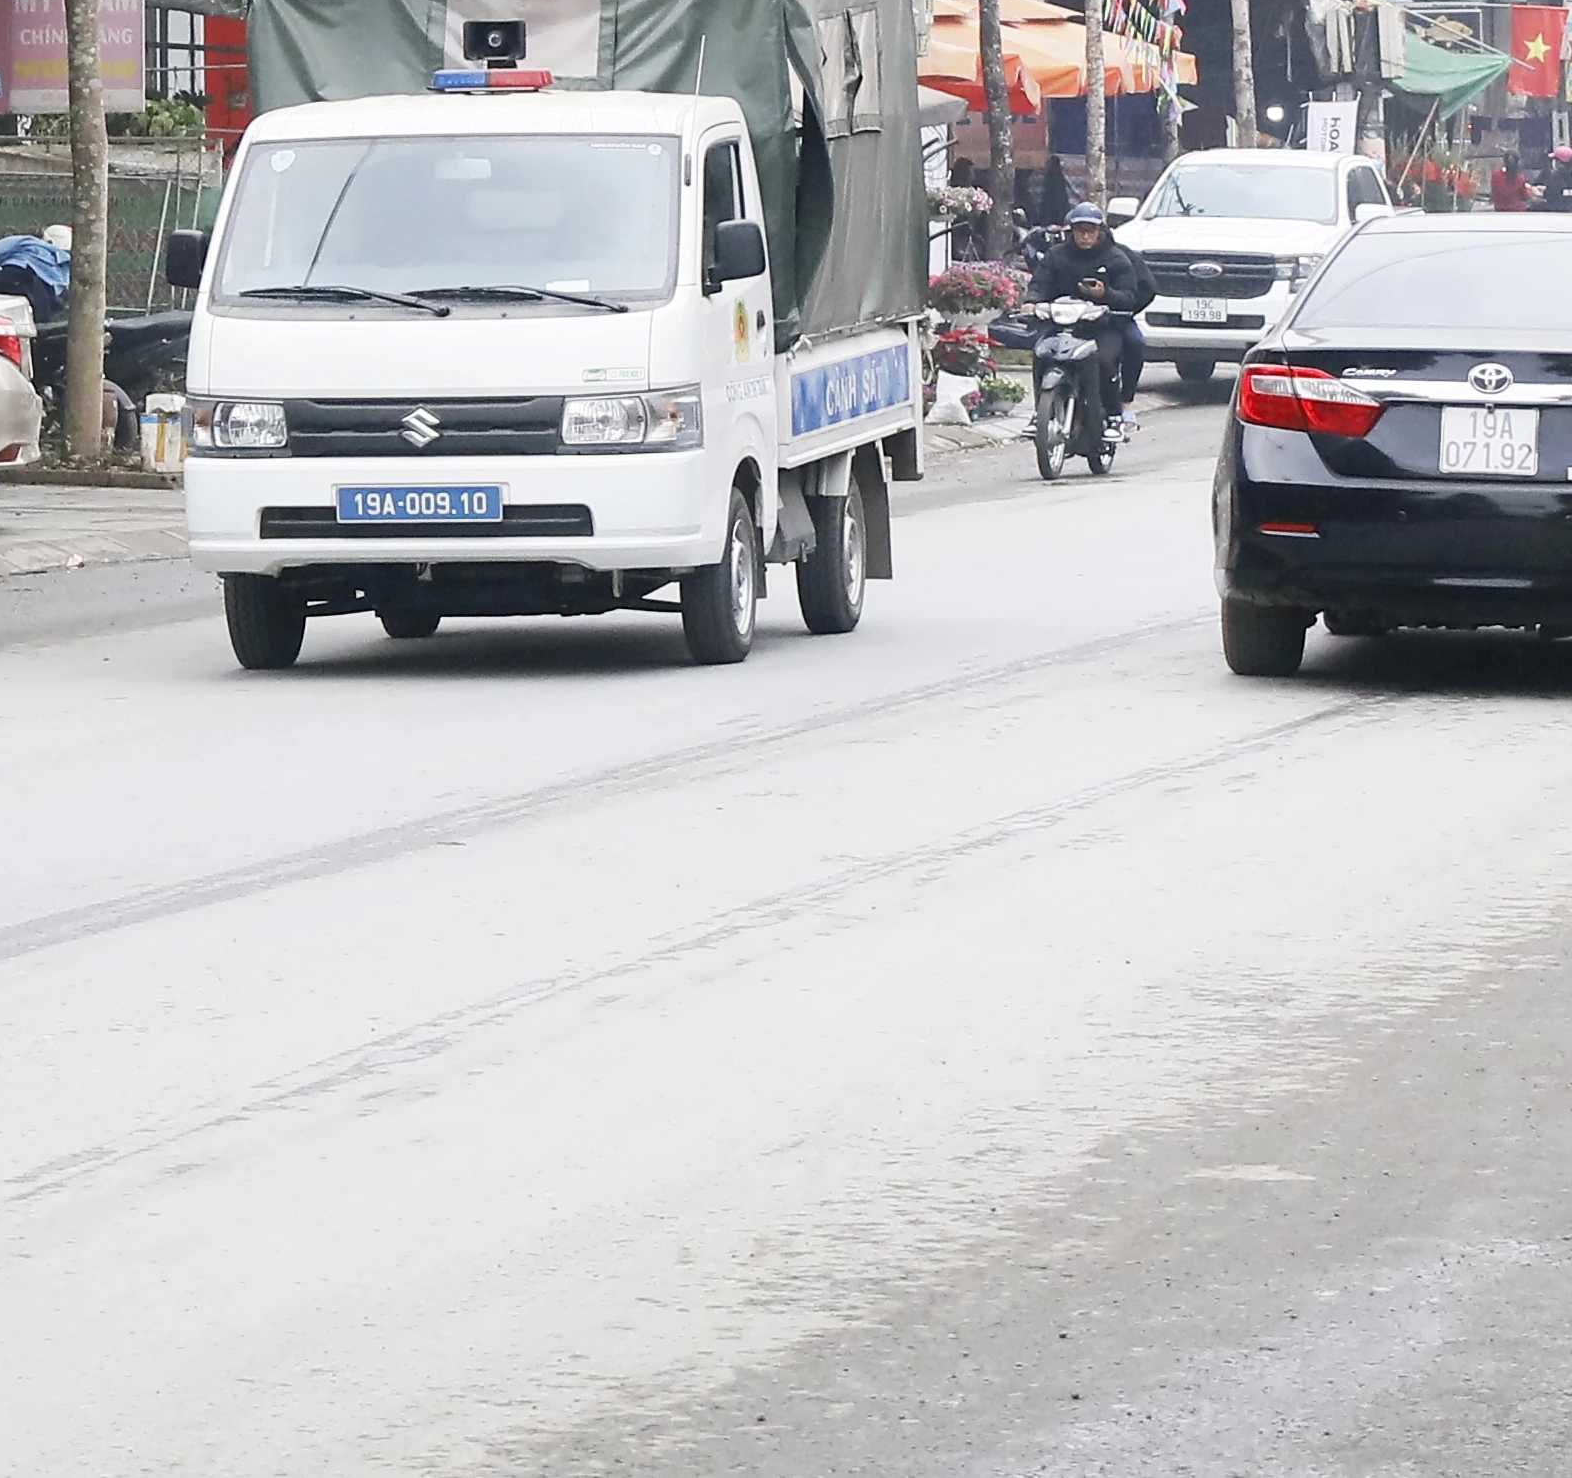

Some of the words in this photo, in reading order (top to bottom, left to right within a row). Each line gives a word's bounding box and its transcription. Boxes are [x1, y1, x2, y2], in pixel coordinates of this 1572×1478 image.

[20, 25, 70, 45] CHÍN
[1187, 310, 1222, 320] 199.98
[1468, 411, 1514, 440] 19A
[1444, 441, 1534, 471] 071.92
[353, 491, 488, 516] 19A-009.10
